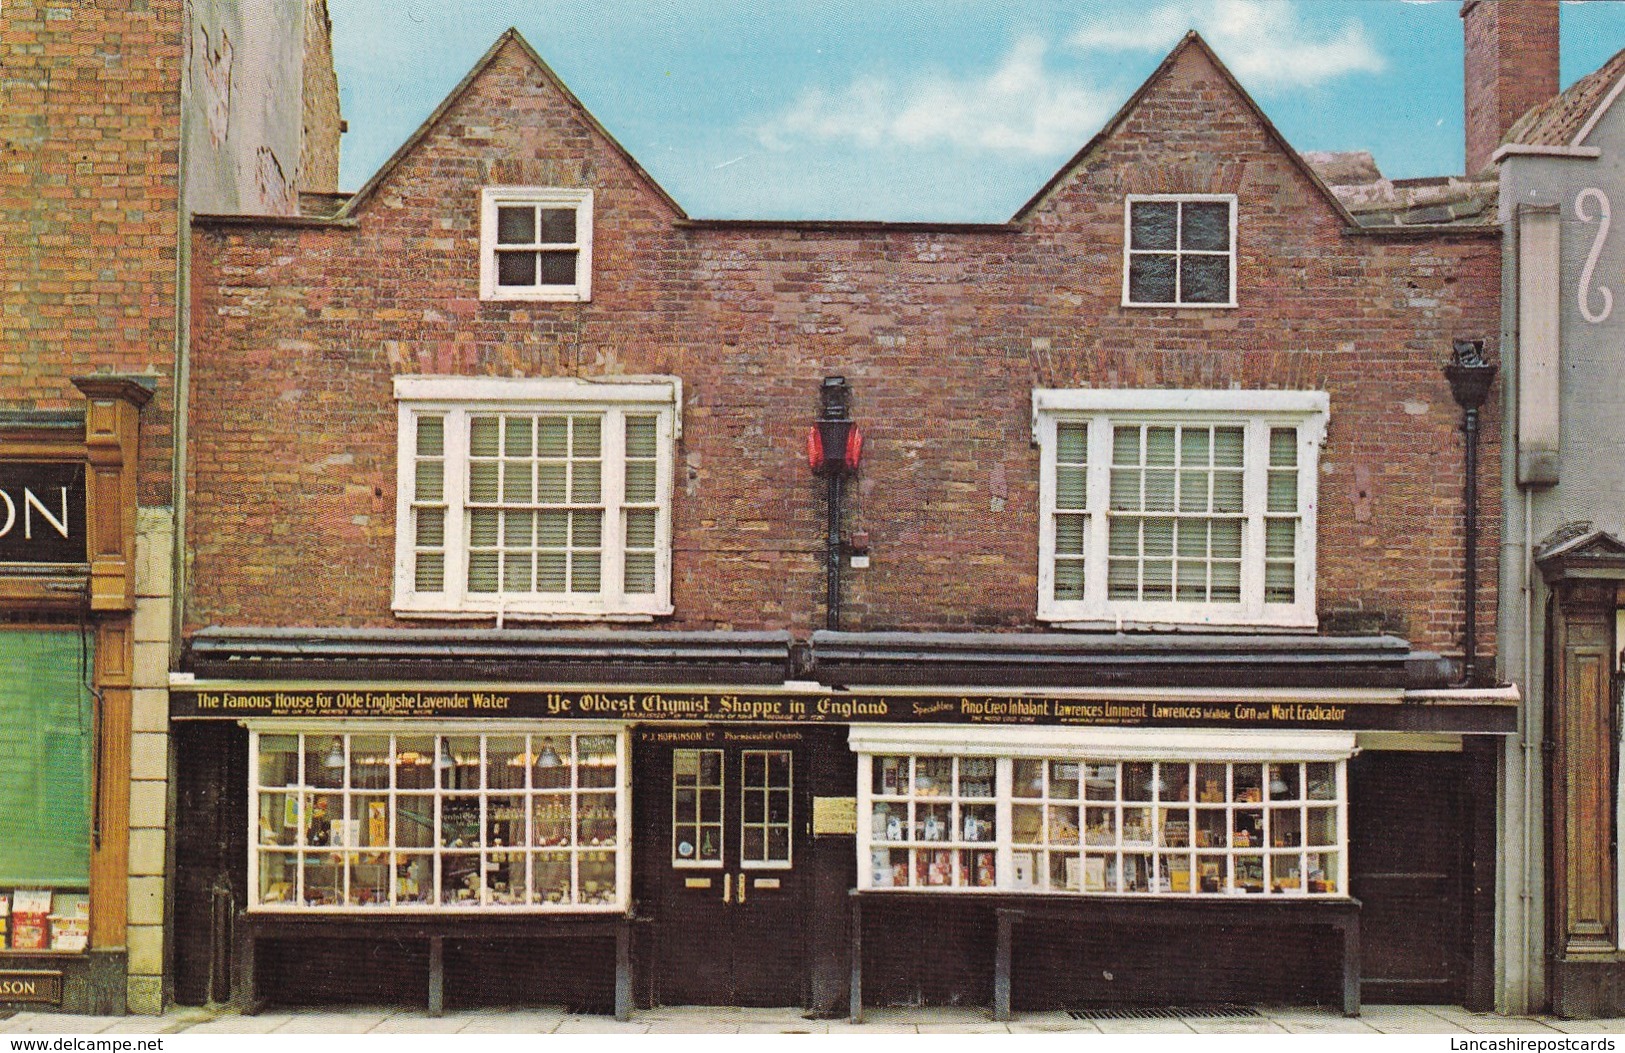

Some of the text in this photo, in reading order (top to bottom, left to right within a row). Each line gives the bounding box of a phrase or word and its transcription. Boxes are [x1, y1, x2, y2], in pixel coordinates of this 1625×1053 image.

[197, 692, 511, 711] The Famous House for Olde Englyshe Lavender Water
[547, 693, 888, 718] Ye Oldest Chymist Shoppe in England
[961, 697, 1050, 716] Pino Creo Inhalant
[1054, 700, 1148, 718] Lawrences Liniment
[1152, 702, 1202, 719] Lawrences
[1234, 704, 1256, 719] Corn
[1257, 710, 1270, 720] and
[1271, 704, 1295, 720] Wart
[1297, 704, 1346, 721] Eradicator
[657, 732, 702, 740] HOPKINSON
[724, 731, 774, 740] Pharmaceutical
[0, 981, 35, 994] SON
